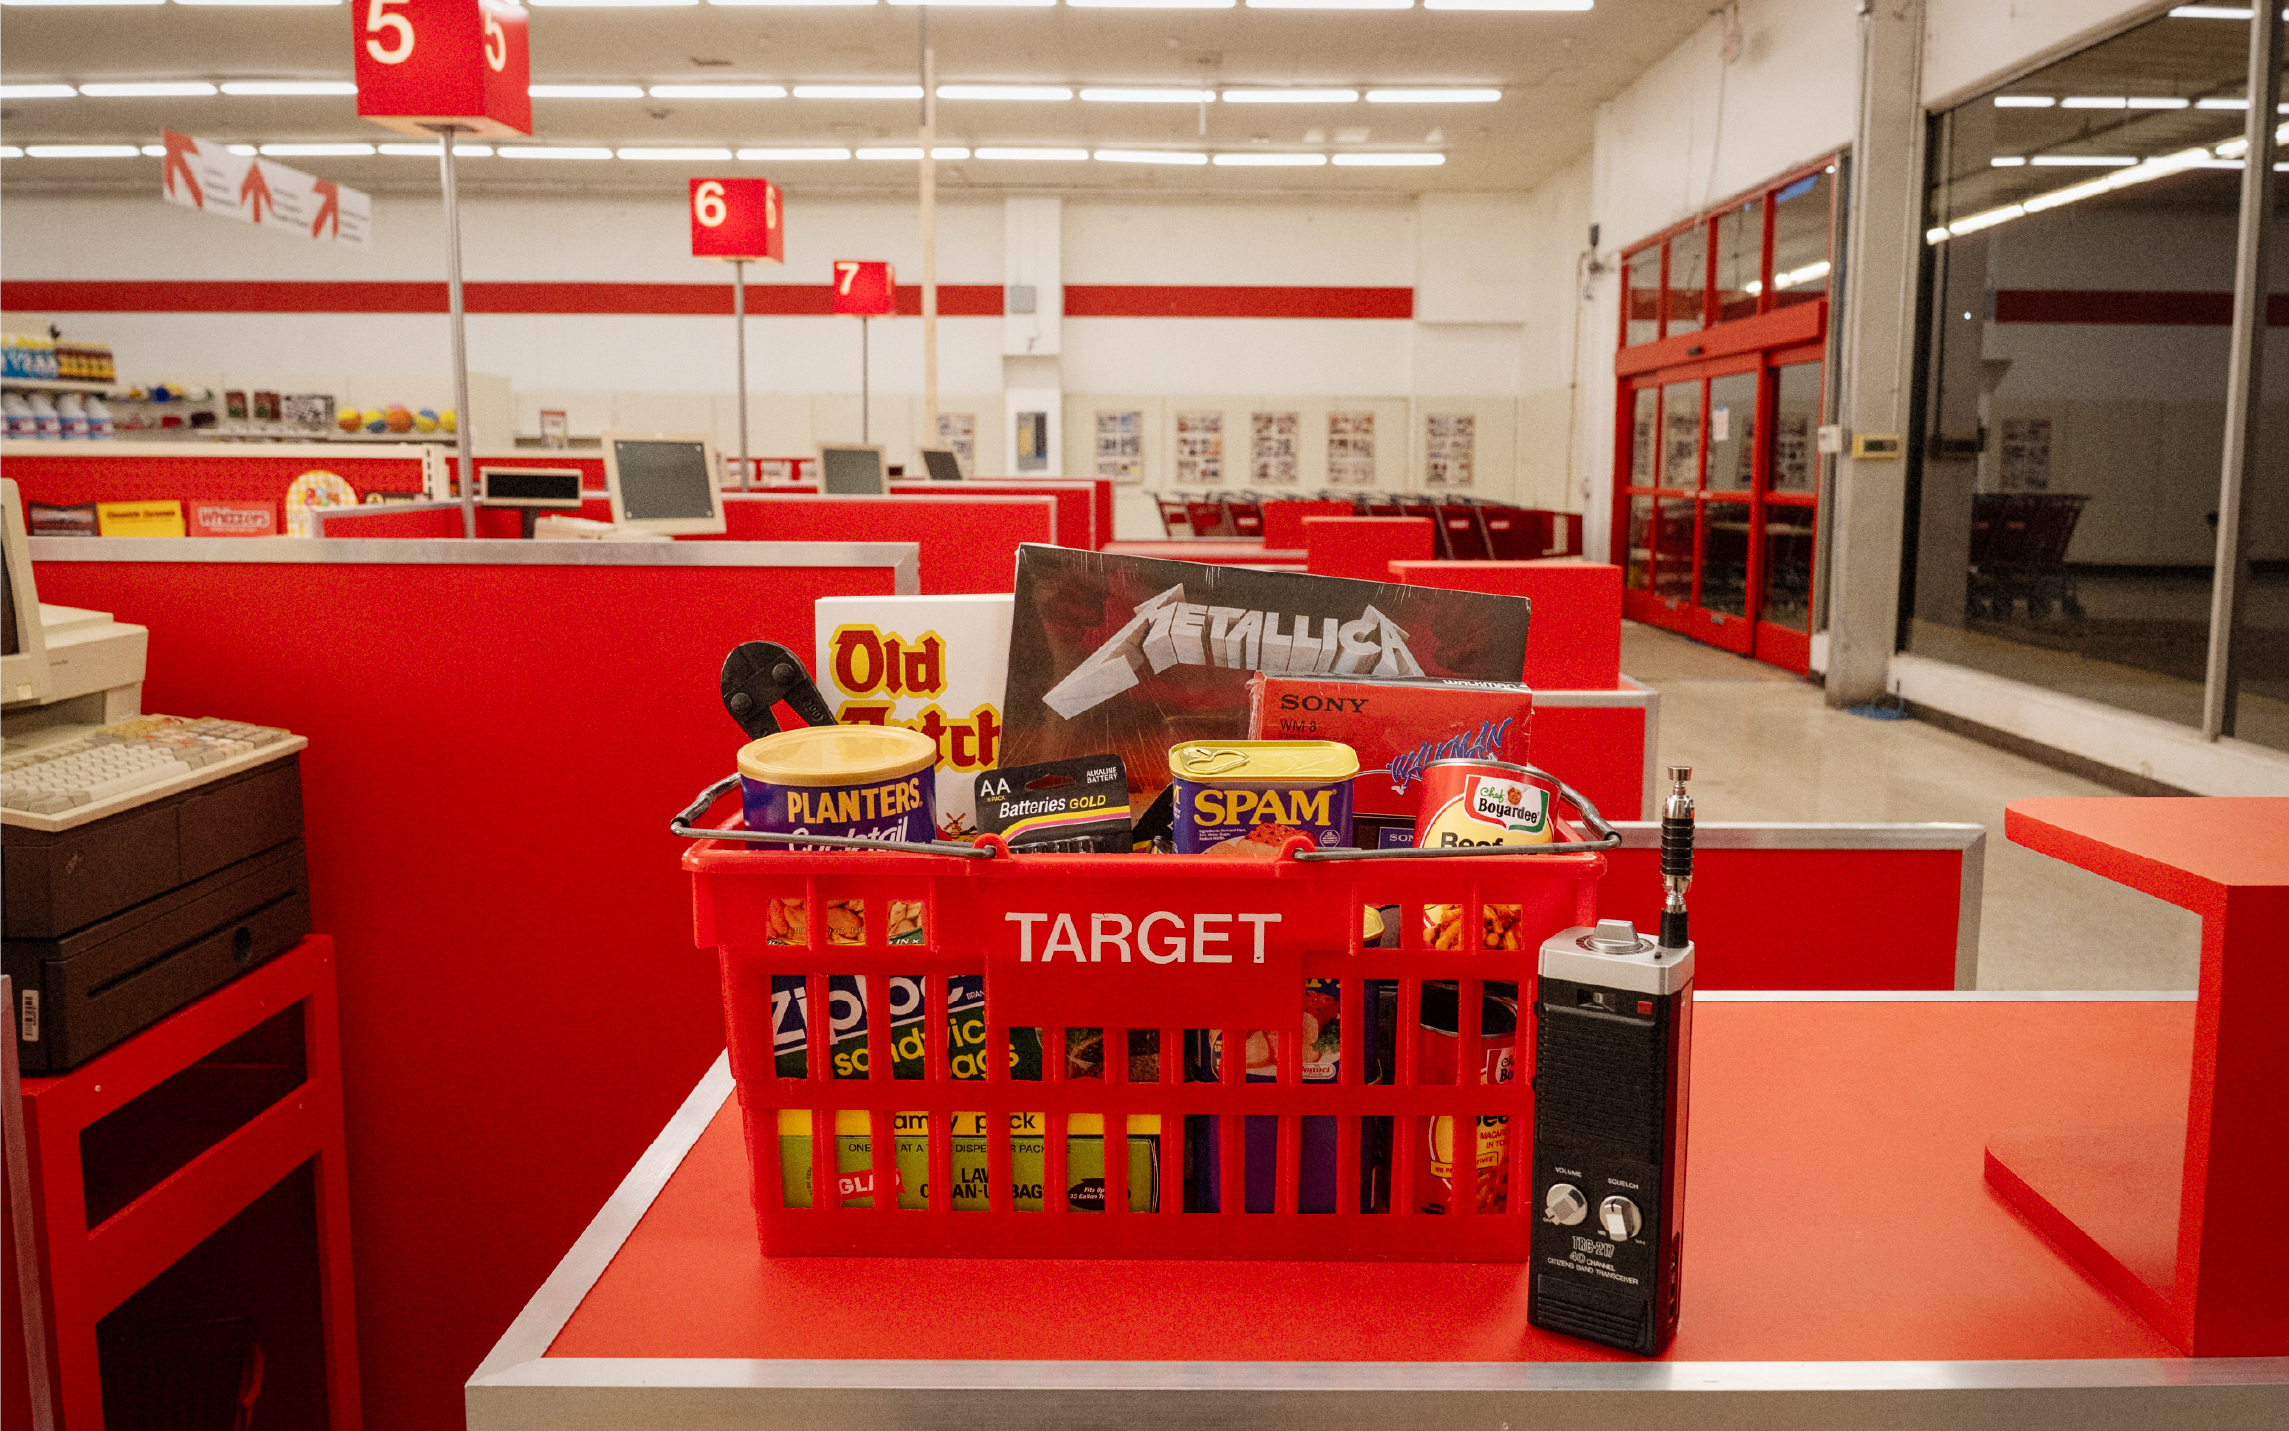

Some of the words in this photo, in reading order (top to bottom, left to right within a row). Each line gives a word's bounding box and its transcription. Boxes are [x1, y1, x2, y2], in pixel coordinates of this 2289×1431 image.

[366, 0, 415, 64] 5
[484, 8, 507, 72] 5
[695, 181, 727, 227] 6
[836, 262, 859, 295] 7
[835, 630, 942, 694] Old
[1042, 583, 1425, 720] METALLICA
[1280, 694, 1369, 713] SONY
[1280, 719, 1317, 732] WM-8
[840, 706, 1001, 768] tch
[1386, 717, 1513, 784] WALKMAN
[1086, 767, 1117, 778] ALKALINE
[1086, 772, 1118, 784] BATTERY
[980, 778, 1012, 797] AA
[1480, 786, 1505, 803] Chef
[787, 777, 921, 824] PLANTERS
[999, 796, 1066, 819] Batteries
[1069, 795, 1106, 810] GOLD
[1194, 789, 1333, 827] SPAM
[1477, 797, 1538, 824] Boyardee
[1389, 834, 1414, 842] SON
[1005, 911, 1282, 964] TARGET
[966, 990, 985, 1001] BRAN
[975, 1112, 1035, 1133] pck
[848, 1144, 871, 1152] ONE
[1555, 1166, 1582, 1177] VOLUME
[1012, 1184, 1044, 1199] BAG
[1607, 1178, 1639, 1189] SQUELCH
[1547, 1257, 1575, 1270] CITIZENS
[1576, 1264, 1594, 1274] BAND
[1595, 1269, 1639, 1285] TRANSCEIVER
[1569, 1251, 1586, 1264] 40
[1586, 1258, 1616, 1272] CHANNEL
